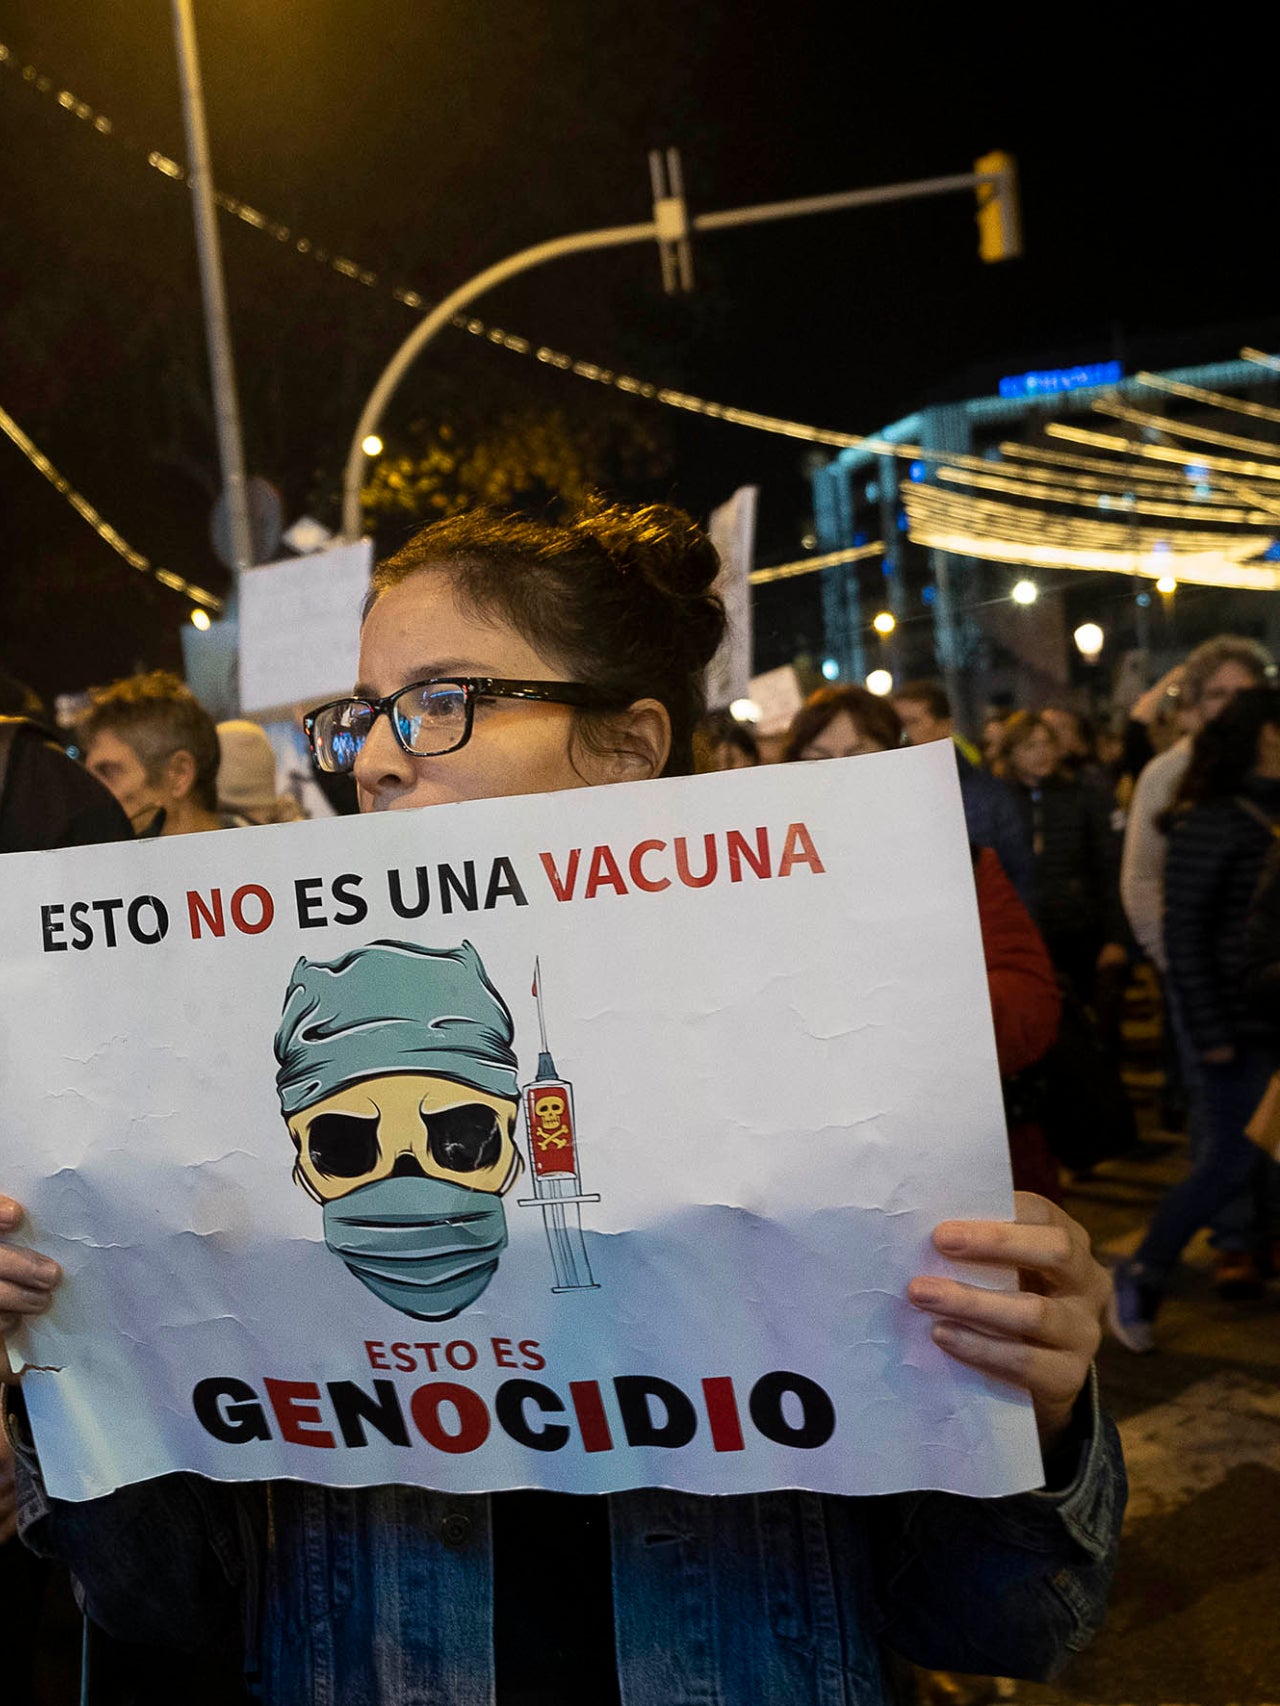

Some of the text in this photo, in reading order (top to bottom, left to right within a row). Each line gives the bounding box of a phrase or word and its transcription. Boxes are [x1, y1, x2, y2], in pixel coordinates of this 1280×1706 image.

[40, 822, 827, 953] ESTO NO ES UNA VACUNA
[363, 1336, 547, 1373] ESTO ES
[192, 1370, 837, 1455] GENOCIDIO
